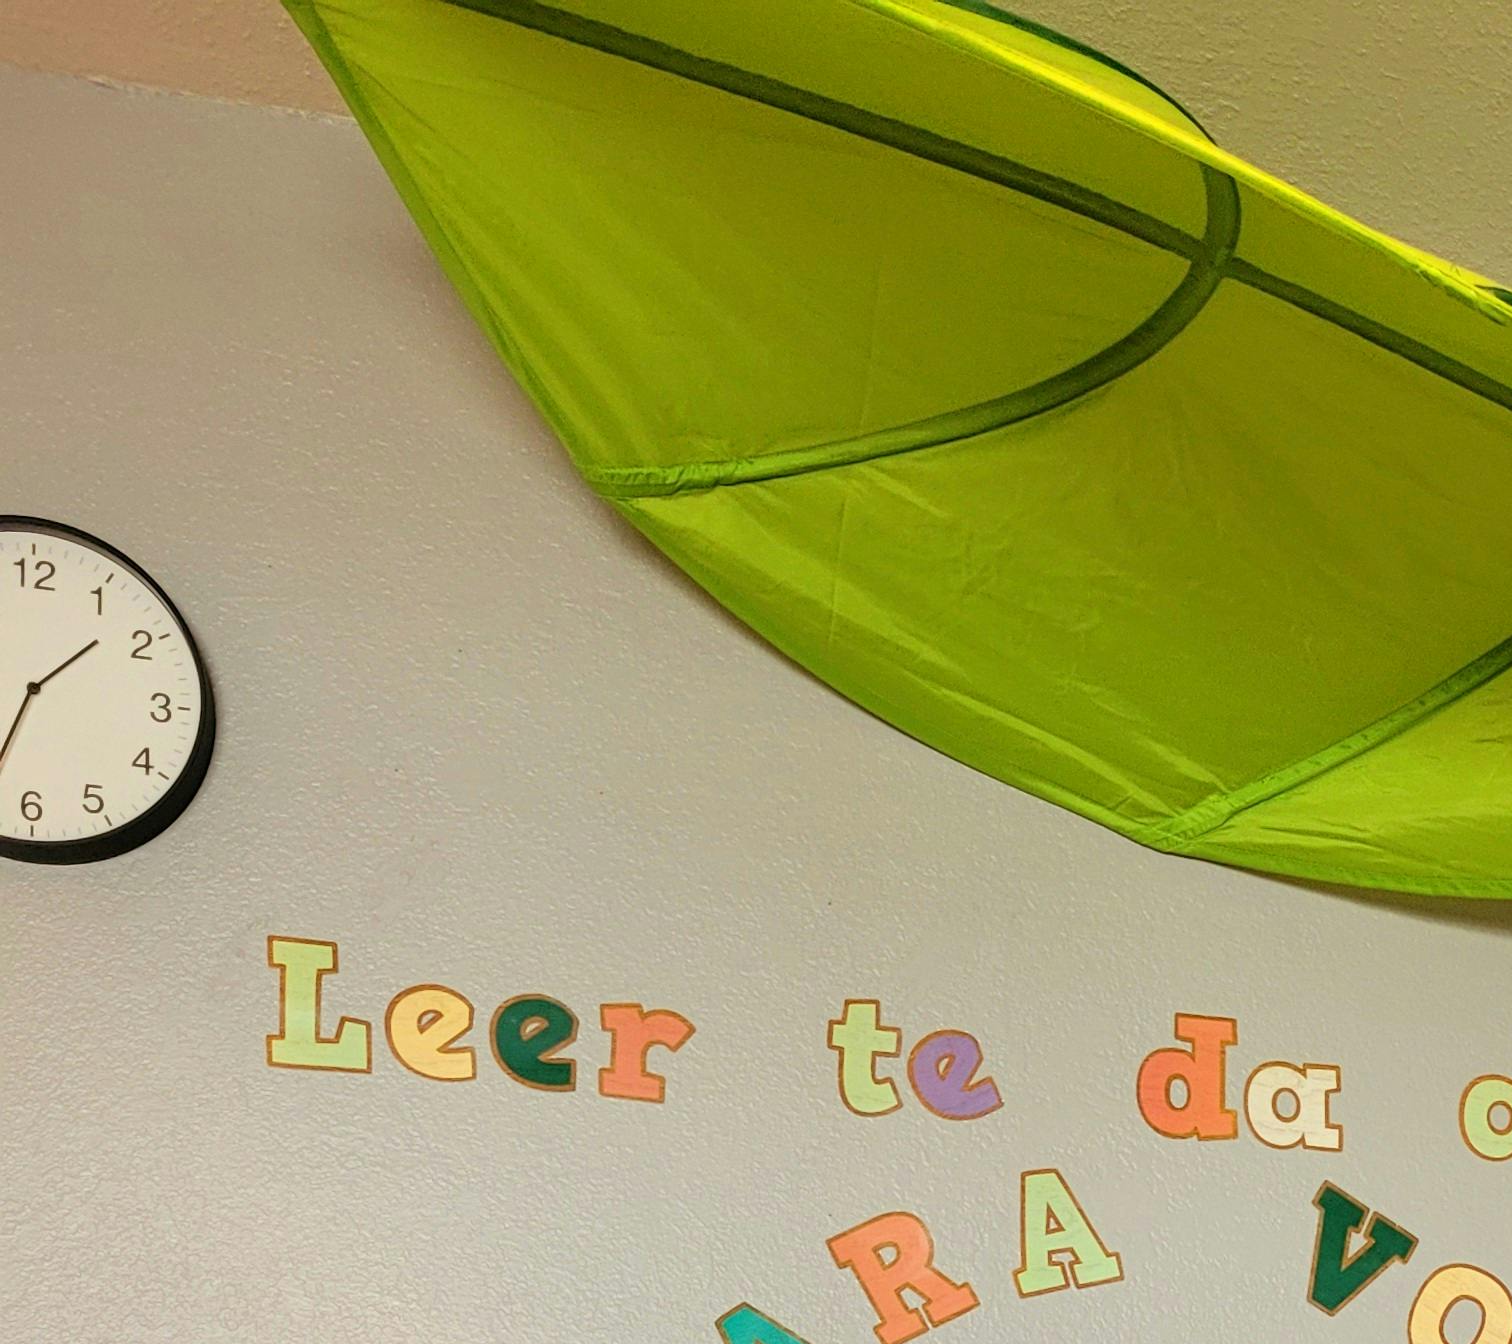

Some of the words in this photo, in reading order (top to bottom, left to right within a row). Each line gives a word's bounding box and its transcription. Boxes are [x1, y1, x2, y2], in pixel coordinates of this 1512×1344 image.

[13, 557, 56, 591] 12
[90, 586, 102, 616] 1
[131, 629, 153, 660] 2
[150, 692, 172, 723] 3
[131, 747, 154, 776] 4
[20, 790, 43, 822] 6
[82, 783, 104, 814] 5
[267, 935, 697, 1104] Leer
[827, 999, 1004, 1121] te
[1137, 1012, 1344, 1152] da
